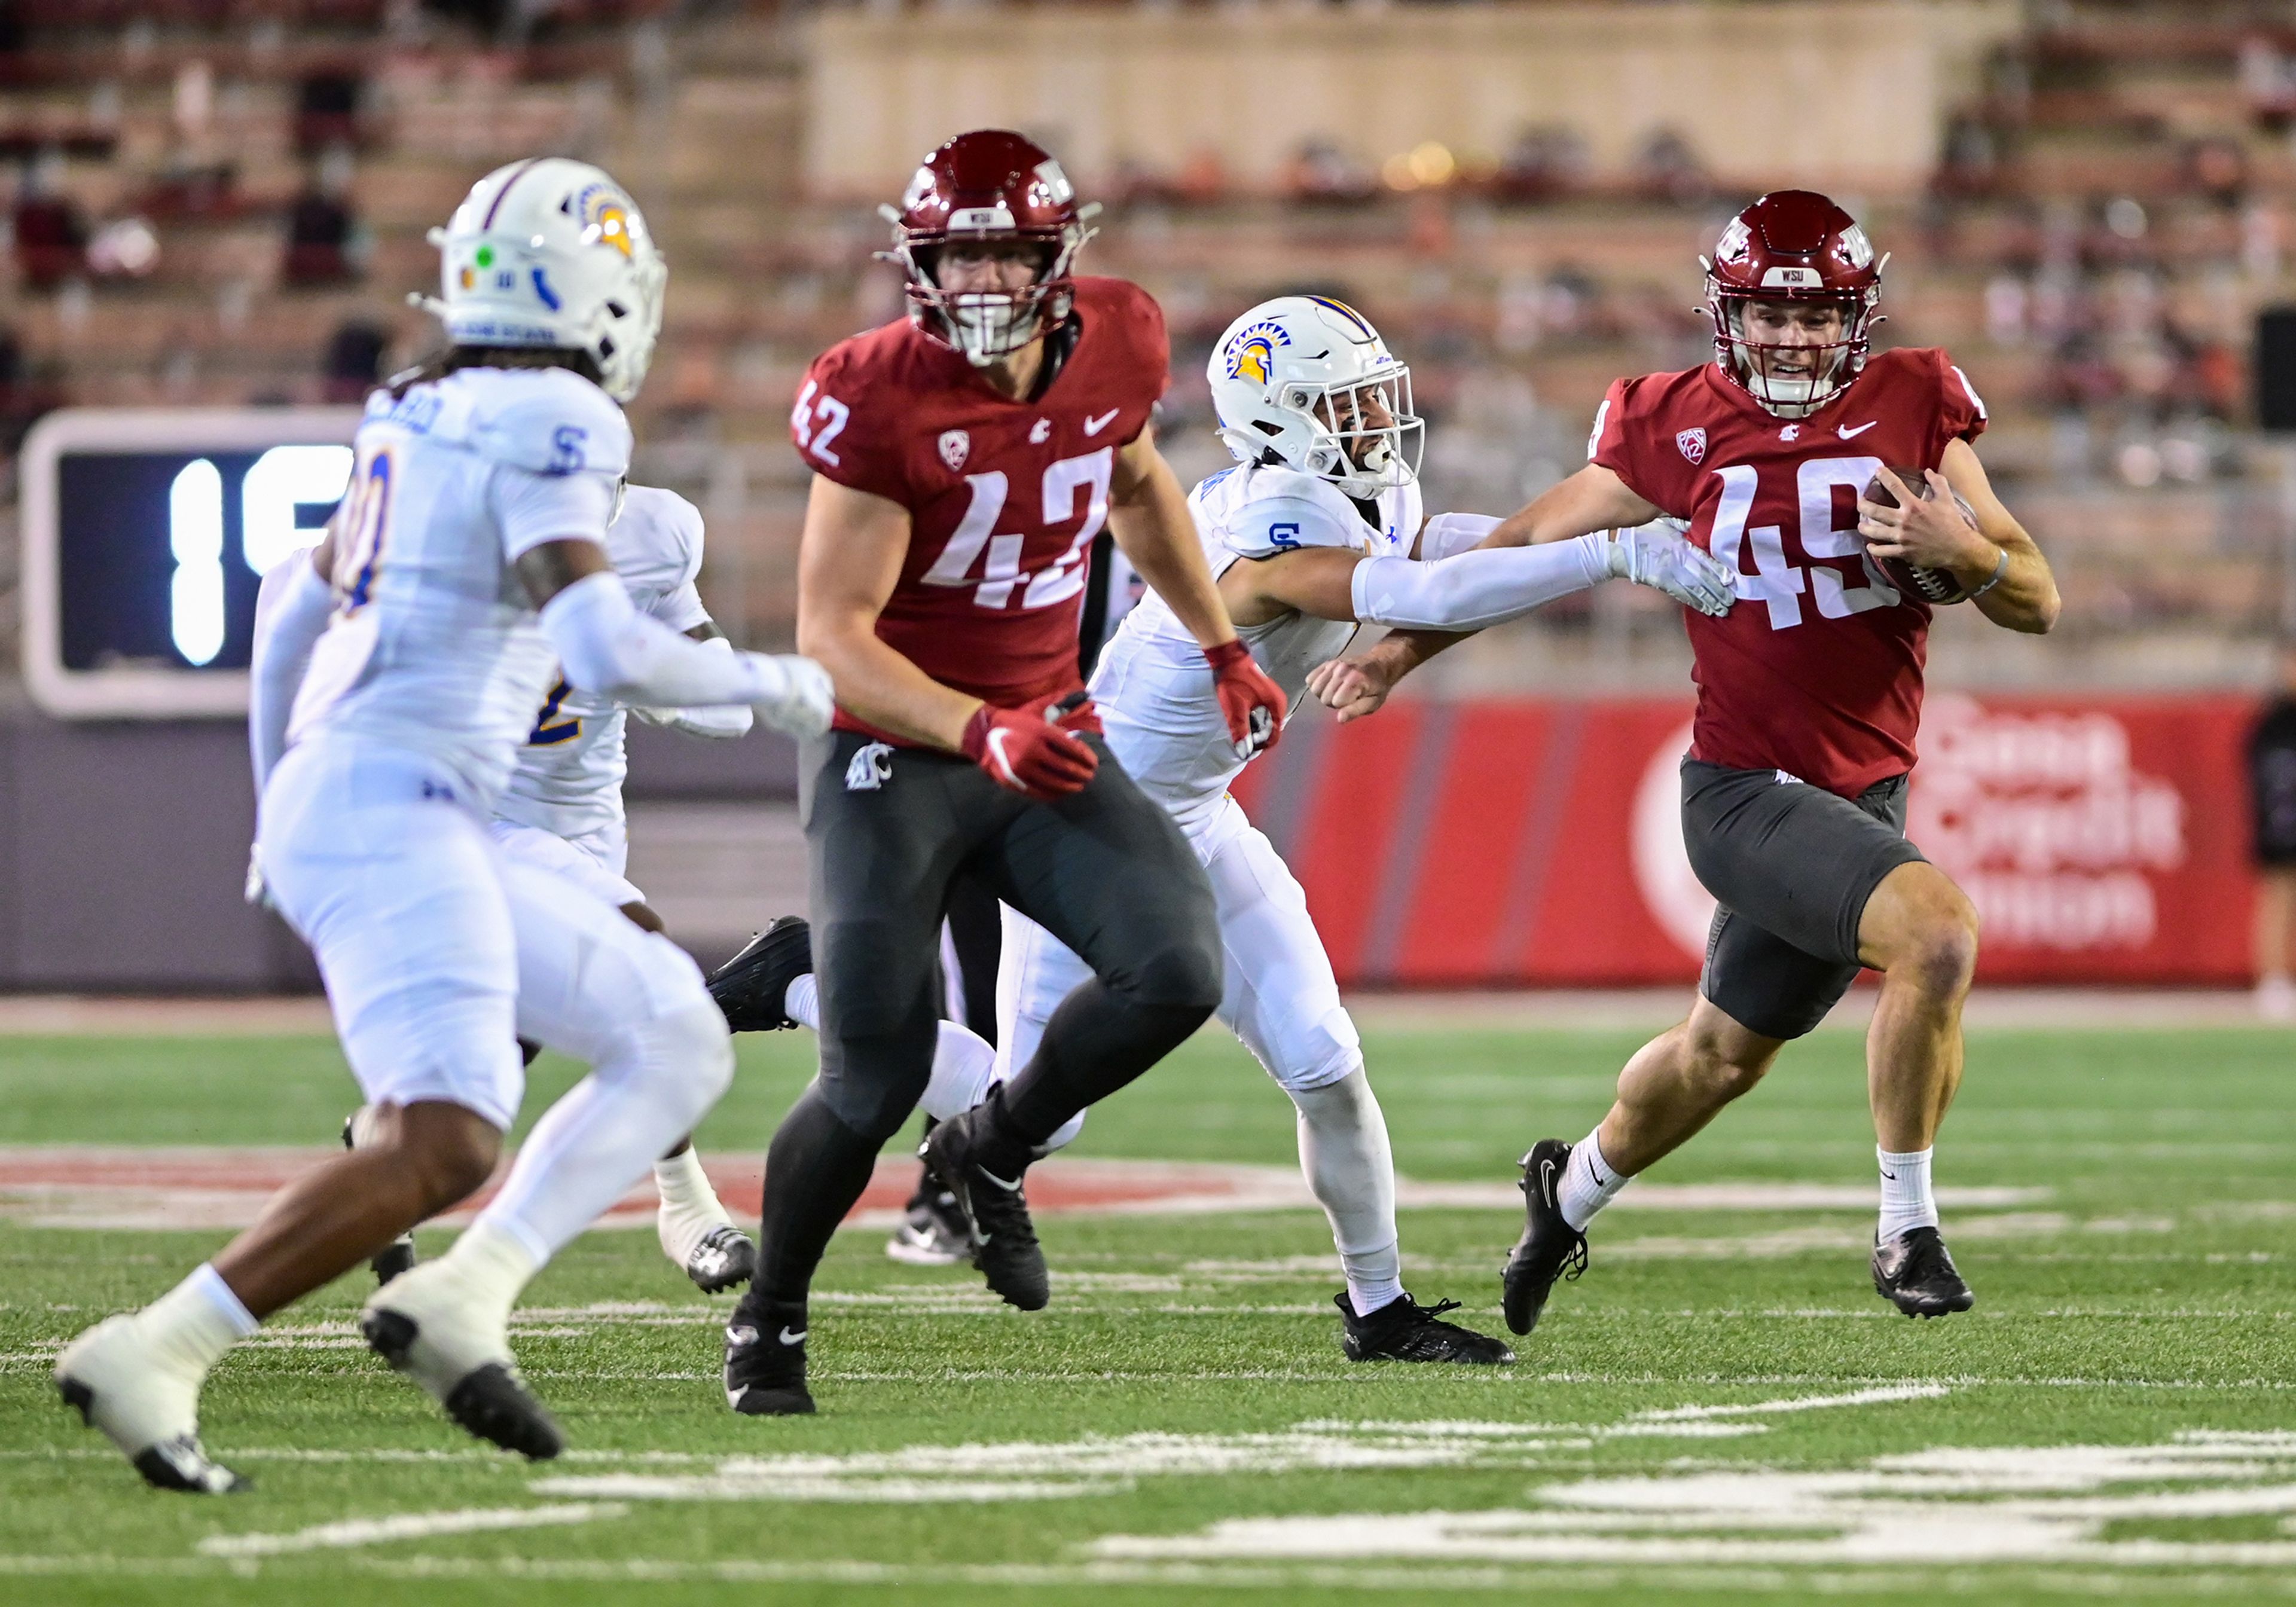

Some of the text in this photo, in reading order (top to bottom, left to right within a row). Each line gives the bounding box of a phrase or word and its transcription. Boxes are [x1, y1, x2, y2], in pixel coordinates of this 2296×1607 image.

[1782, 270, 1804, 282] WSU
[791, 379, 850, 468] 42
[1677, 429, 1704, 453] PAC
[1687, 443, 1702, 459] 12
[920, 446, 1113, 610] 42
[1710, 456, 1901, 631] 49
